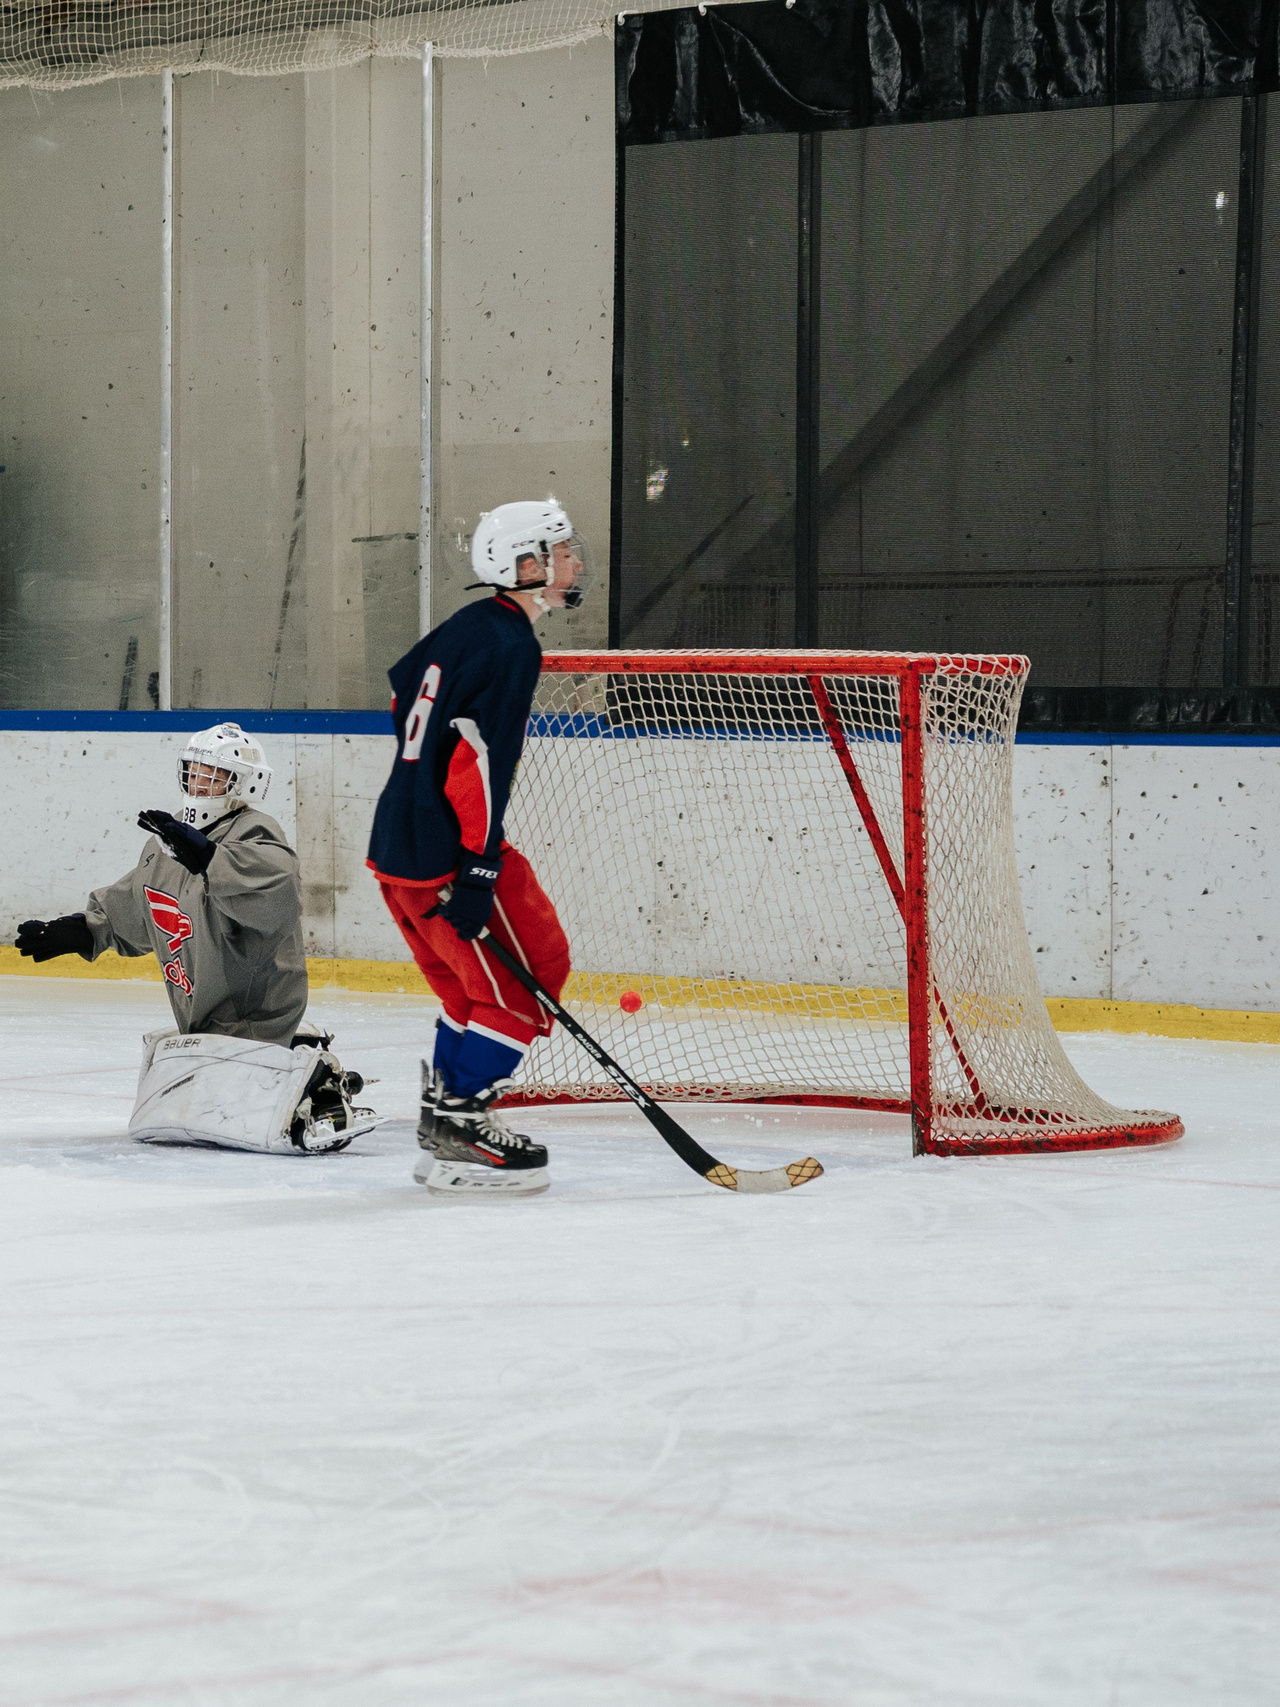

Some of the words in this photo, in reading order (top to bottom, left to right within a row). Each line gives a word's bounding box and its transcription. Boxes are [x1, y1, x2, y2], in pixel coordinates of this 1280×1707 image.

[402, 662, 442, 762] 6
[163, 1038, 202, 1051] BAUER
[575, 1033, 603, 1060] RAIDER
[604, 1064, 652, 1109] STEX
